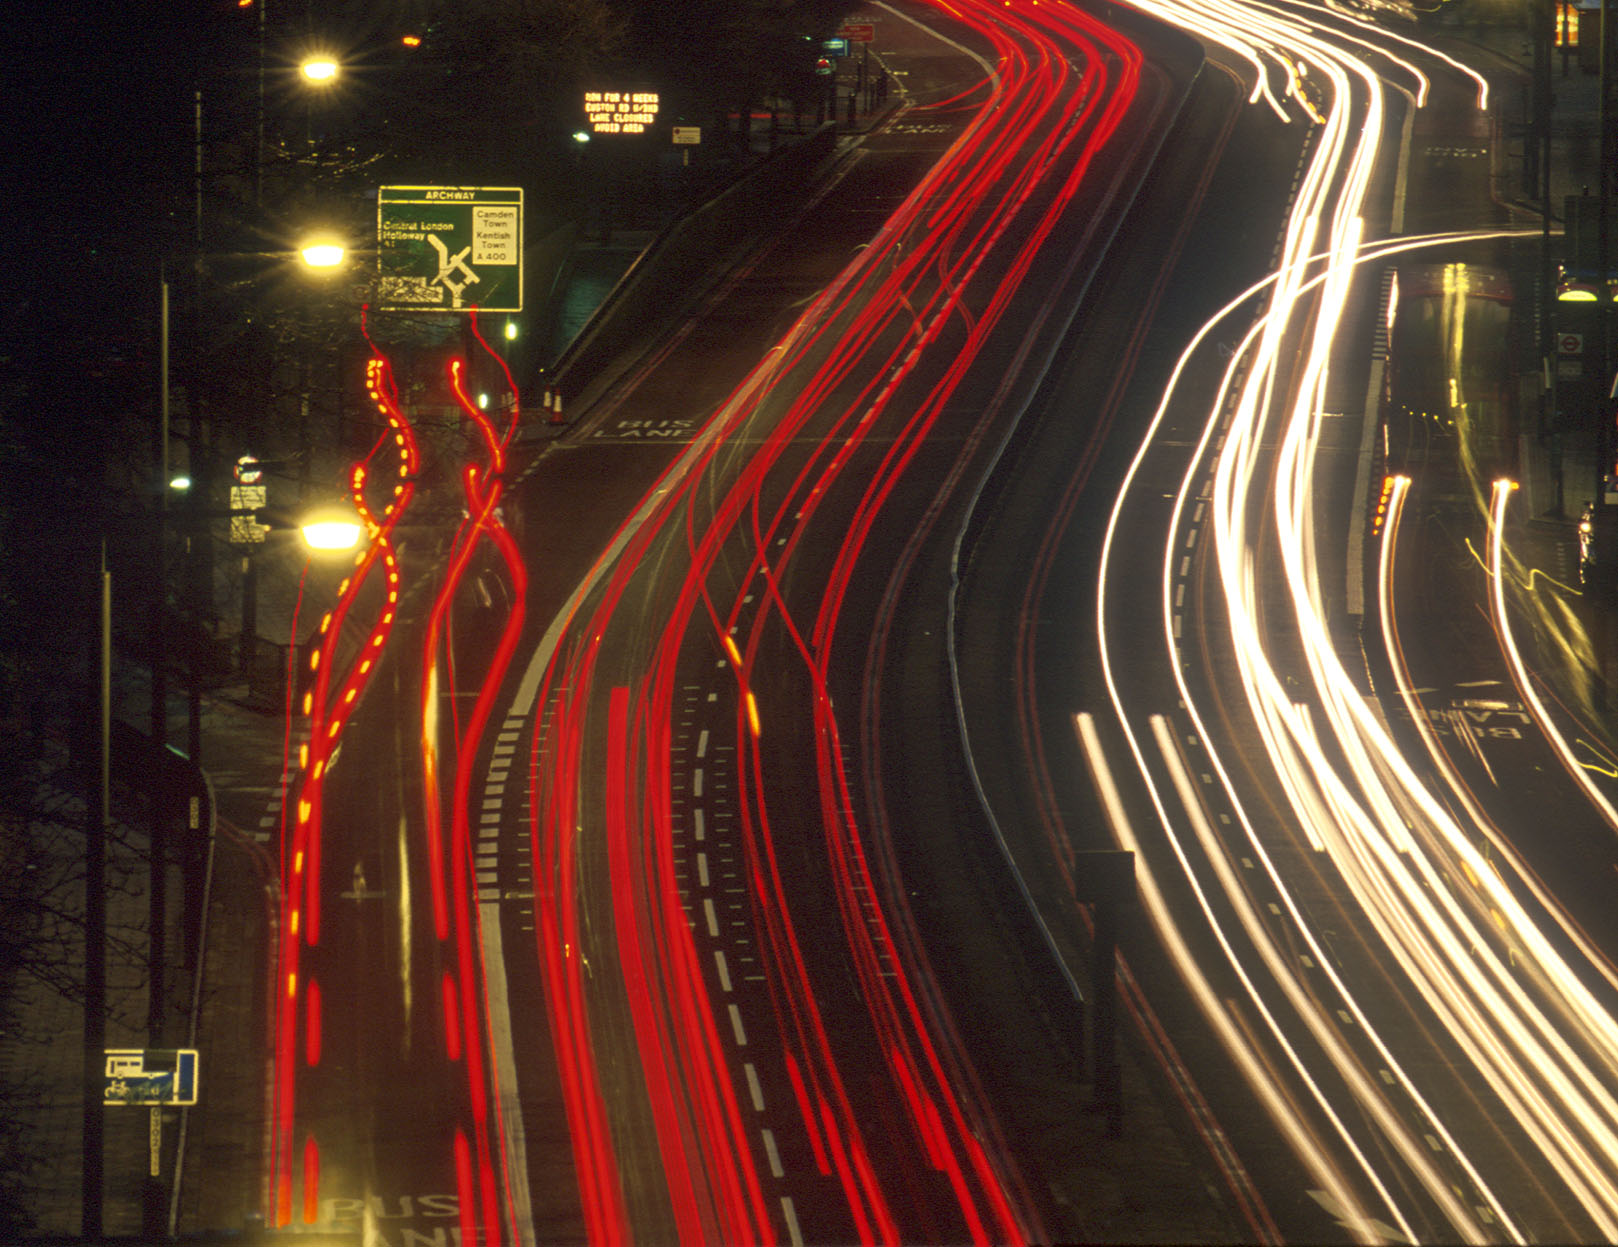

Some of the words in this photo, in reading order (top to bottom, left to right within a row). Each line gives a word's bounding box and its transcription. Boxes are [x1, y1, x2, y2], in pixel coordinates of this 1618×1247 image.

[632, 93, 659, 103] WEEKS
[589, 113, 611, 122] LANE
[613, 113, 655, 123] CLOSURES
[594, 123, 620, 132] AVOID
[622, 123, 644, 133] AREA
[425, 191, 475, 200] ARCHWAY
[476, 210, 514, 219] Camden
[420, 221, 454, 231] London
[483, 220, 508, 228] Town
[383, 231, 426, 241] Holloway
[476, 232, 511, 240] Kentish
[482, 241, 506, 249] Town
[476, 253, 483, 261] A
[485, 253, 506, 261] 400
[617, 419, 695, 429] BUS
[593, 429, 697, 438] LANE
[321, 1194, 461, 1220] BUS
